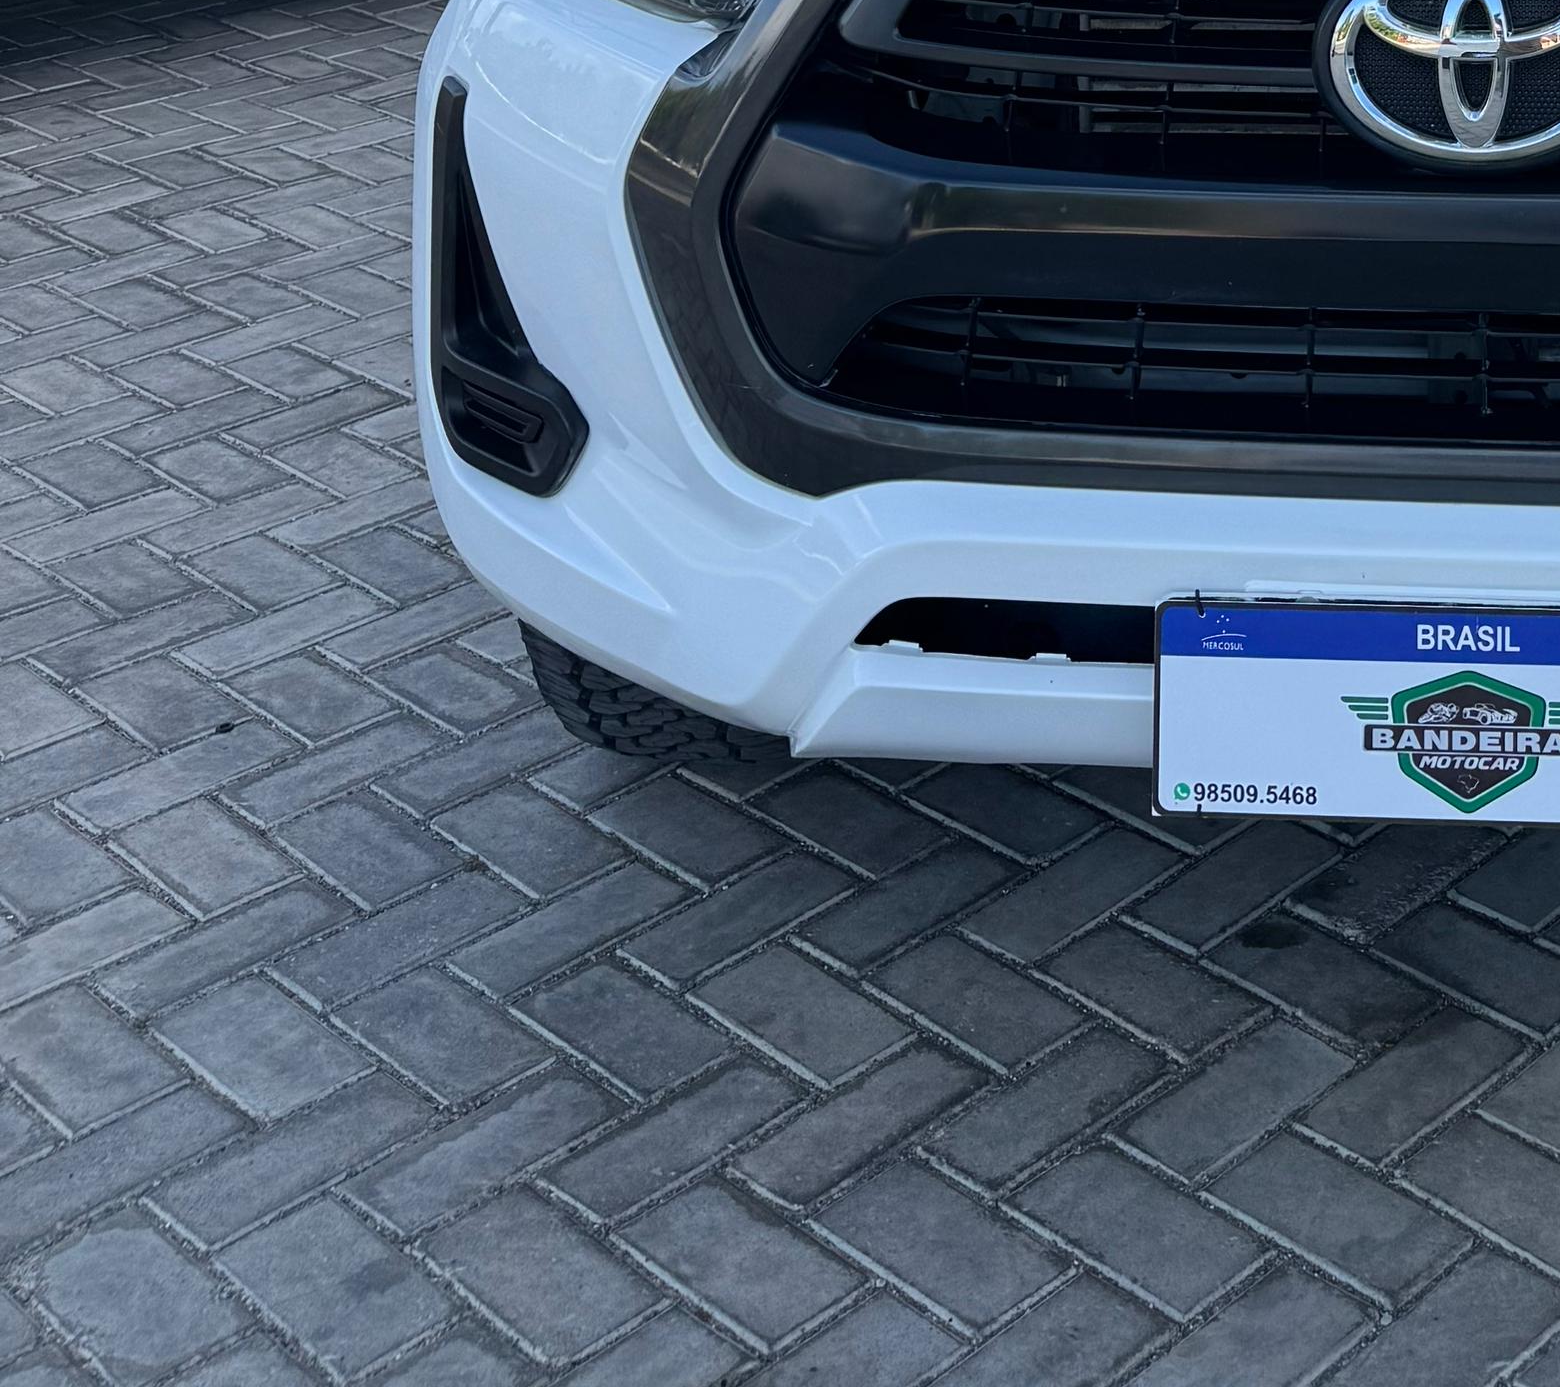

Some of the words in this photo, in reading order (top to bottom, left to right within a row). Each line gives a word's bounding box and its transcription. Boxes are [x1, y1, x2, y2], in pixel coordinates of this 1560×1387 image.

[1202, 640, 1244, 651] MERCOSUL
[1416, 624, 1520, 653] BRASIL
[1418, 755, 1520, 772] MOTOCAR
[1193, 783, 1318, 805] 98509.5468
